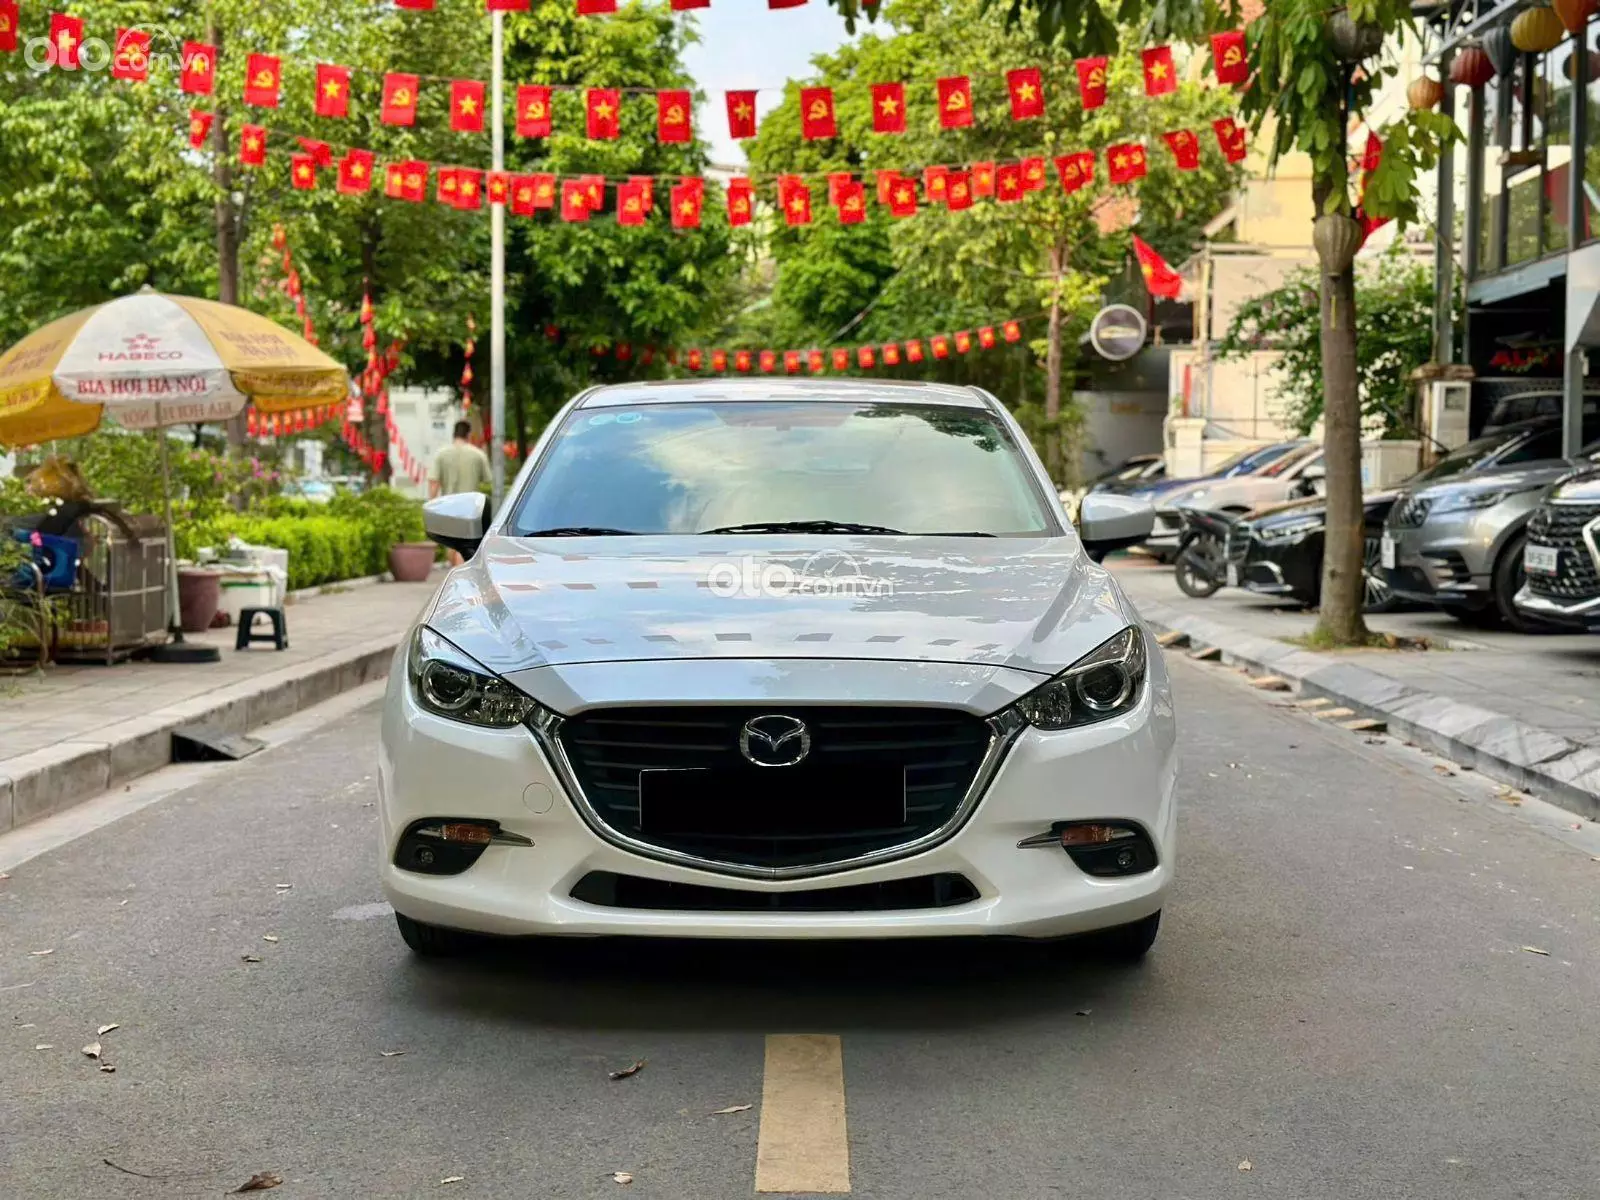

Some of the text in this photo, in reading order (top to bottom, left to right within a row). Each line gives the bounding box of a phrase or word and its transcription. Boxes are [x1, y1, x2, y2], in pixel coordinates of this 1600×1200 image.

[98, 351, 183, 361] HABECO
[77, 379, 107, 394] BIA
[175, 374, 207, 395] NỘI
